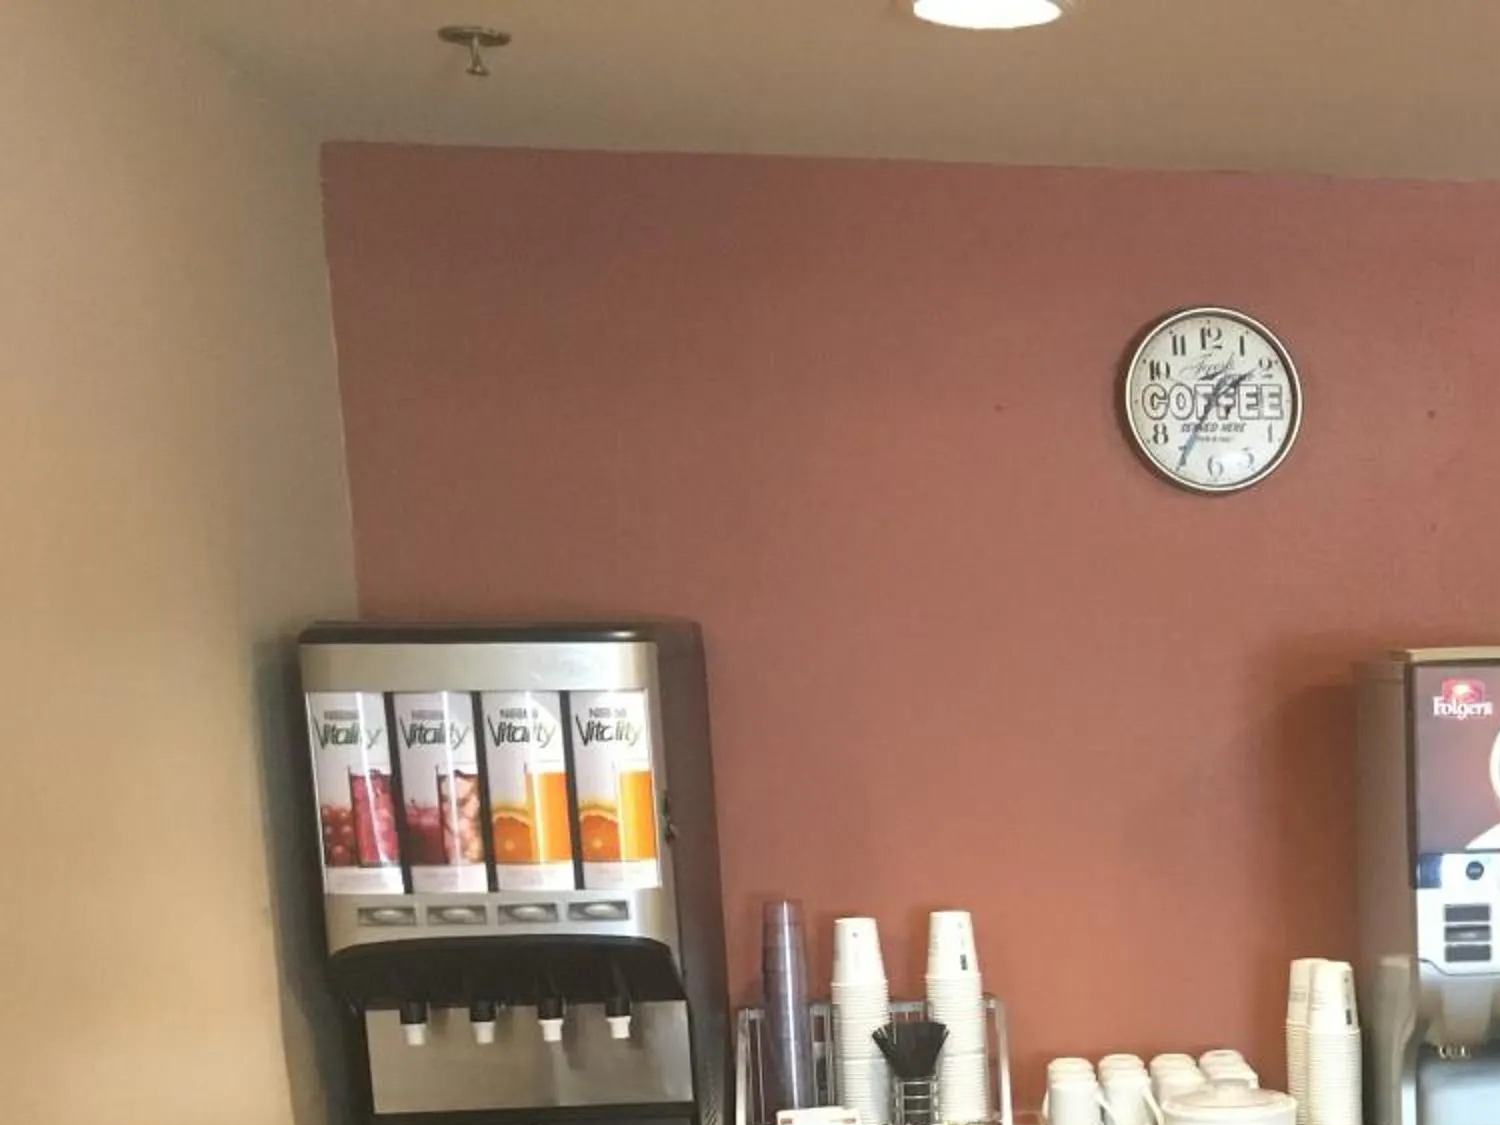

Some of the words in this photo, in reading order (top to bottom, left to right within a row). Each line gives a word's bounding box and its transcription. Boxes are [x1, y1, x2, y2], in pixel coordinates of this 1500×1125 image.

[1172, 334, 1187, 356] 11
[1200, 327, 1223, 350] 12
[1239, 335, 1246, 357] 1
[1149, 359, 1171, 381] 10
[1258, 357, 1273, 378] 2
[1141, 383, 1284, 420] COFFEE
[1153, 423, 1169, 445] 8
[1207, 455, 1224, 477] 6
[1433, 696, 1494, 720] Folgers
[313, 716, 383, 749] Vitaliy
[400, 716, 470, 750] Vitalty
[487, 714, 557, 748] Vitaity
